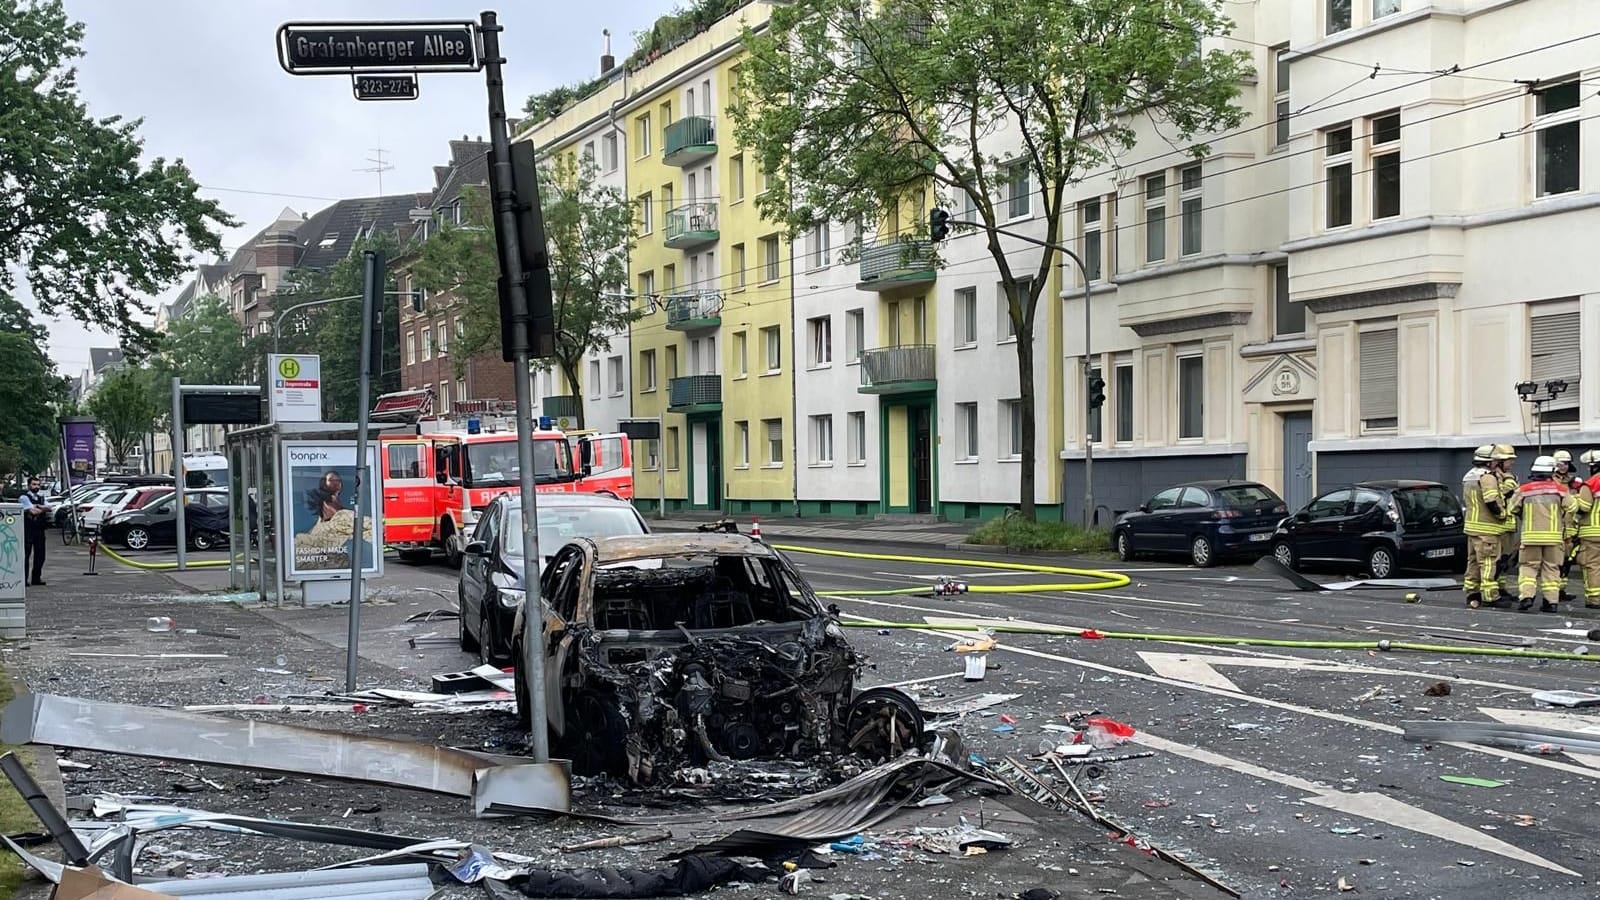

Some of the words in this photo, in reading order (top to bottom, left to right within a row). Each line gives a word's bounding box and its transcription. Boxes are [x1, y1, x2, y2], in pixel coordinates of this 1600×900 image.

[297, 35, 414, 61] Grafenberger
[423, 34, 465, 56] Allee
[362, 80, 410, 94] 323-275
[284, 362, 295, 374] H
[290, 451, 328, 463] bonprix
[296, 547, 326, 555] FASHION
[327, 545, 349, 554] MADE
